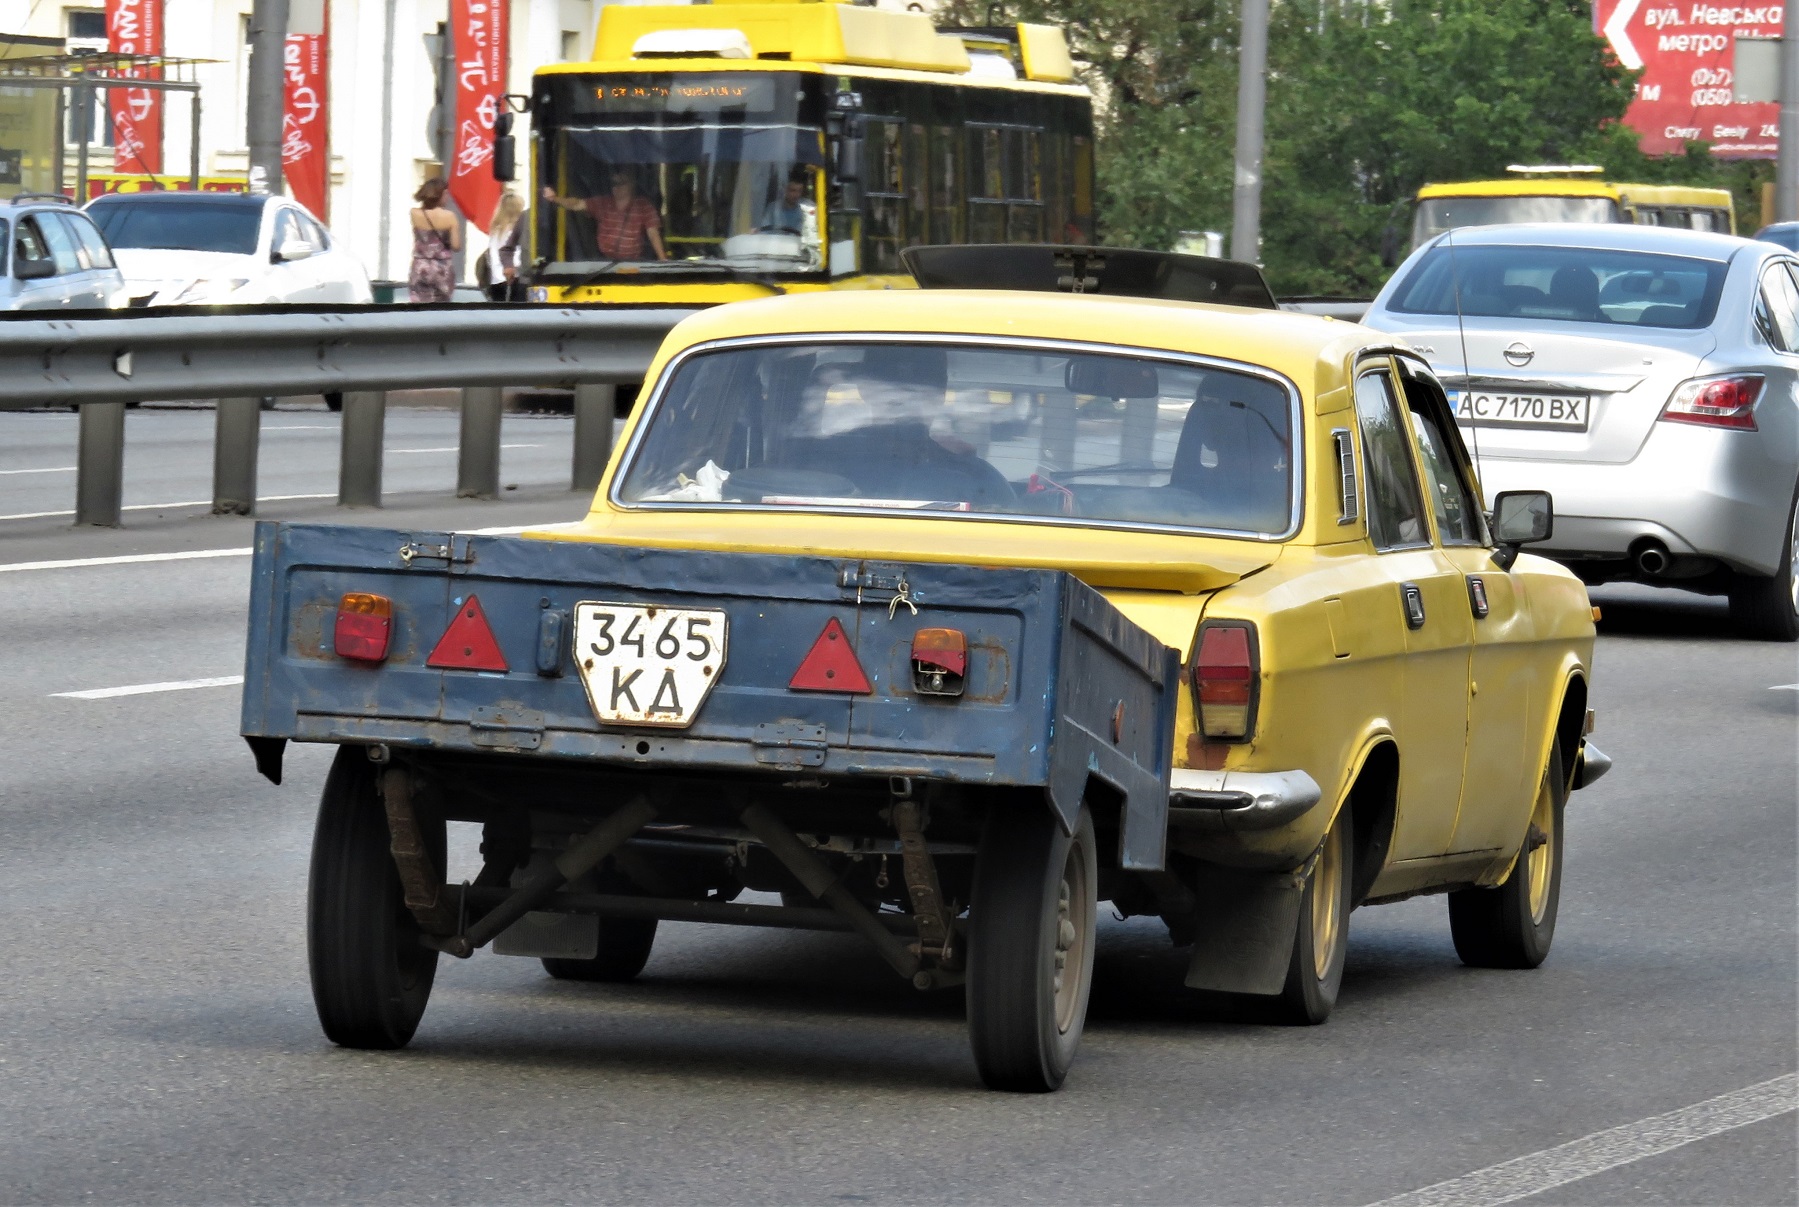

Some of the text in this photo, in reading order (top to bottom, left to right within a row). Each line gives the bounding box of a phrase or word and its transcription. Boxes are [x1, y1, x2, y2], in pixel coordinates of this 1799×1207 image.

[1645, 4, 1783, 30] вул. Невська
[1658, 34, 1727, 57] метро
[1459, 395, 1580, 420] AC 7170 BX
[590, 613, 712, 662] 3465
[610, 666, 683, 717] КД
